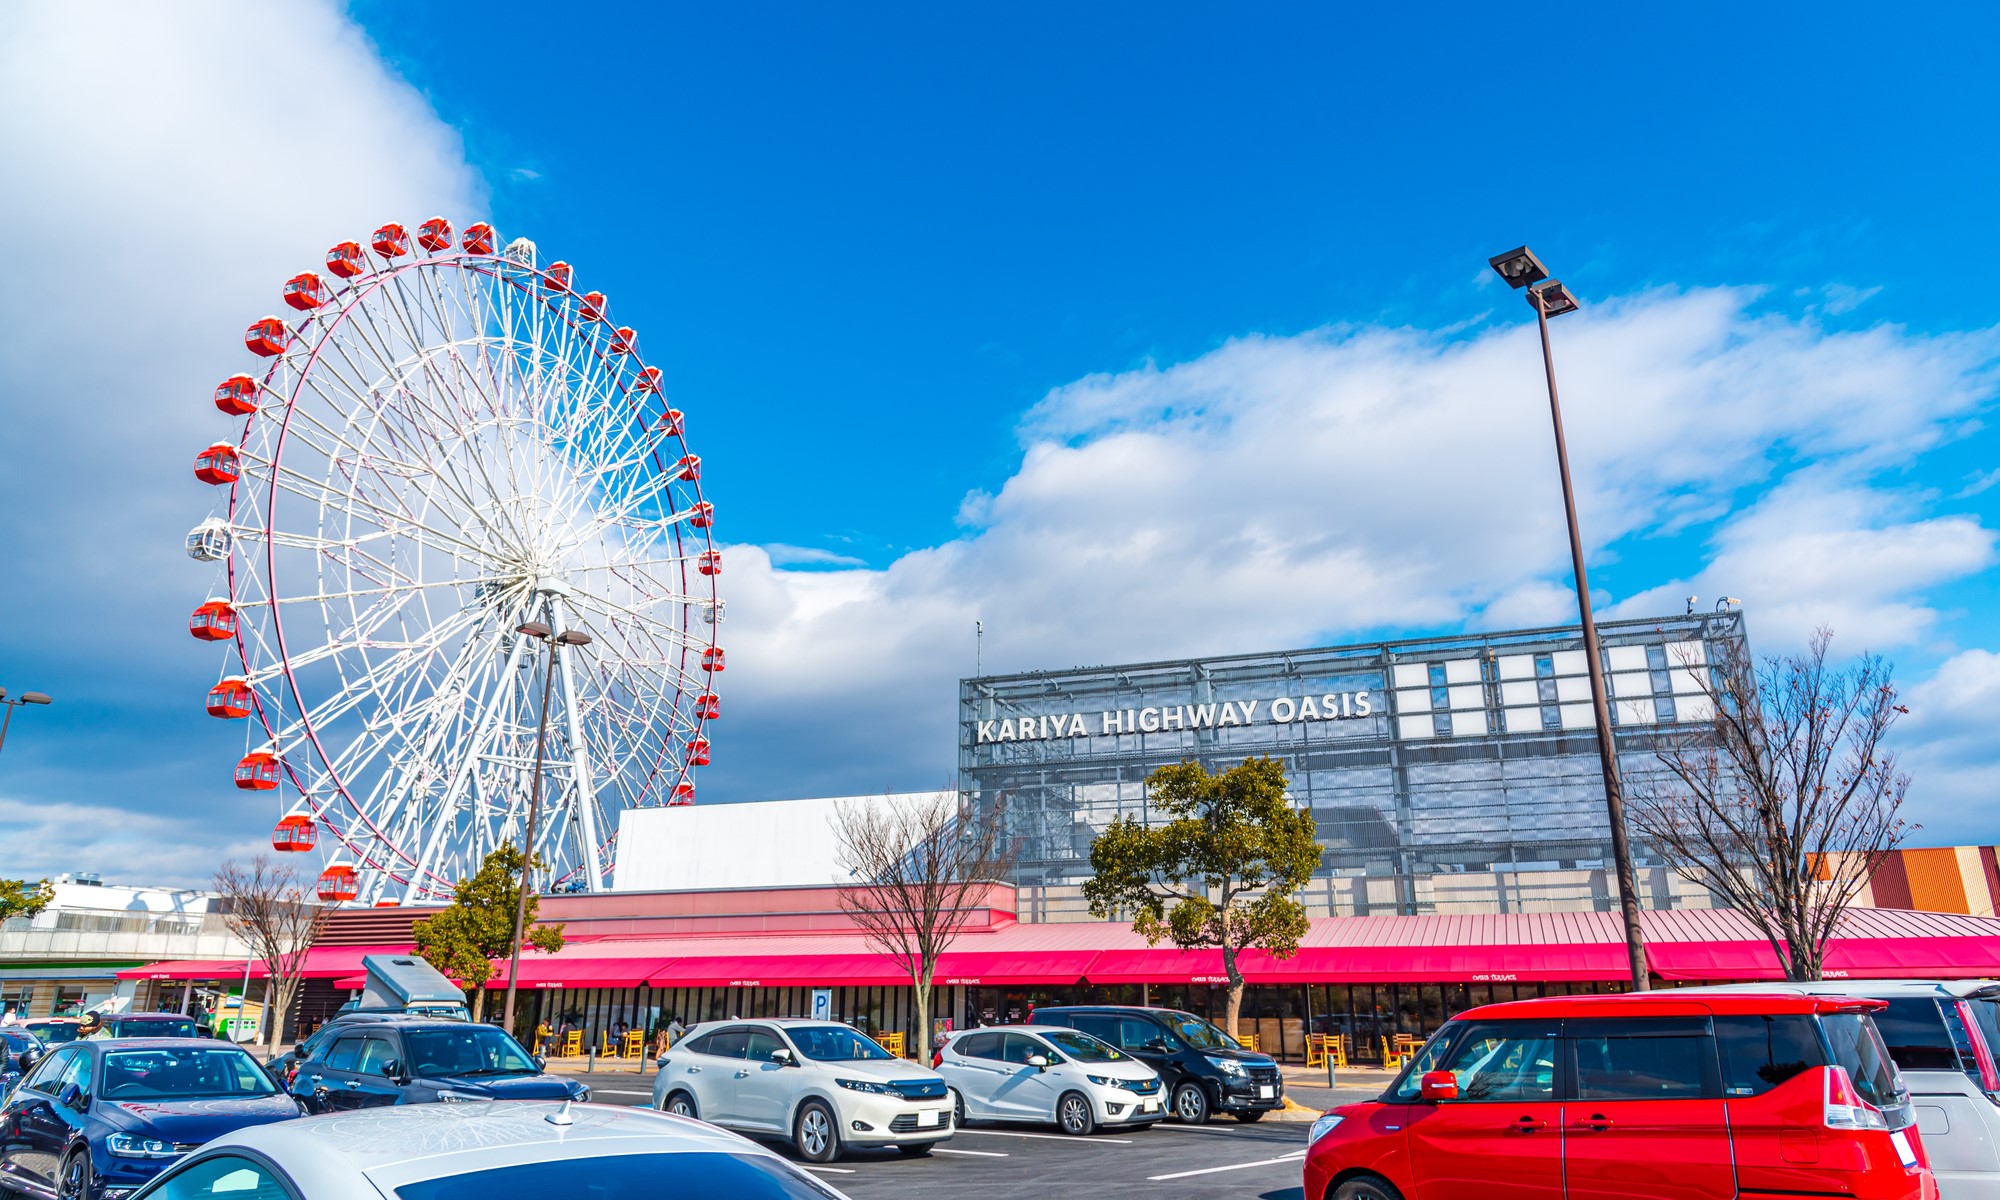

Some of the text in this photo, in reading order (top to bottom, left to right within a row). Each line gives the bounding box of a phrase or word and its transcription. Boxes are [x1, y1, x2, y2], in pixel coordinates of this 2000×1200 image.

[977, 691, 1372, 743] KARIYA HIGHWAY OASIS
[816, 995, 827, 1015] P
